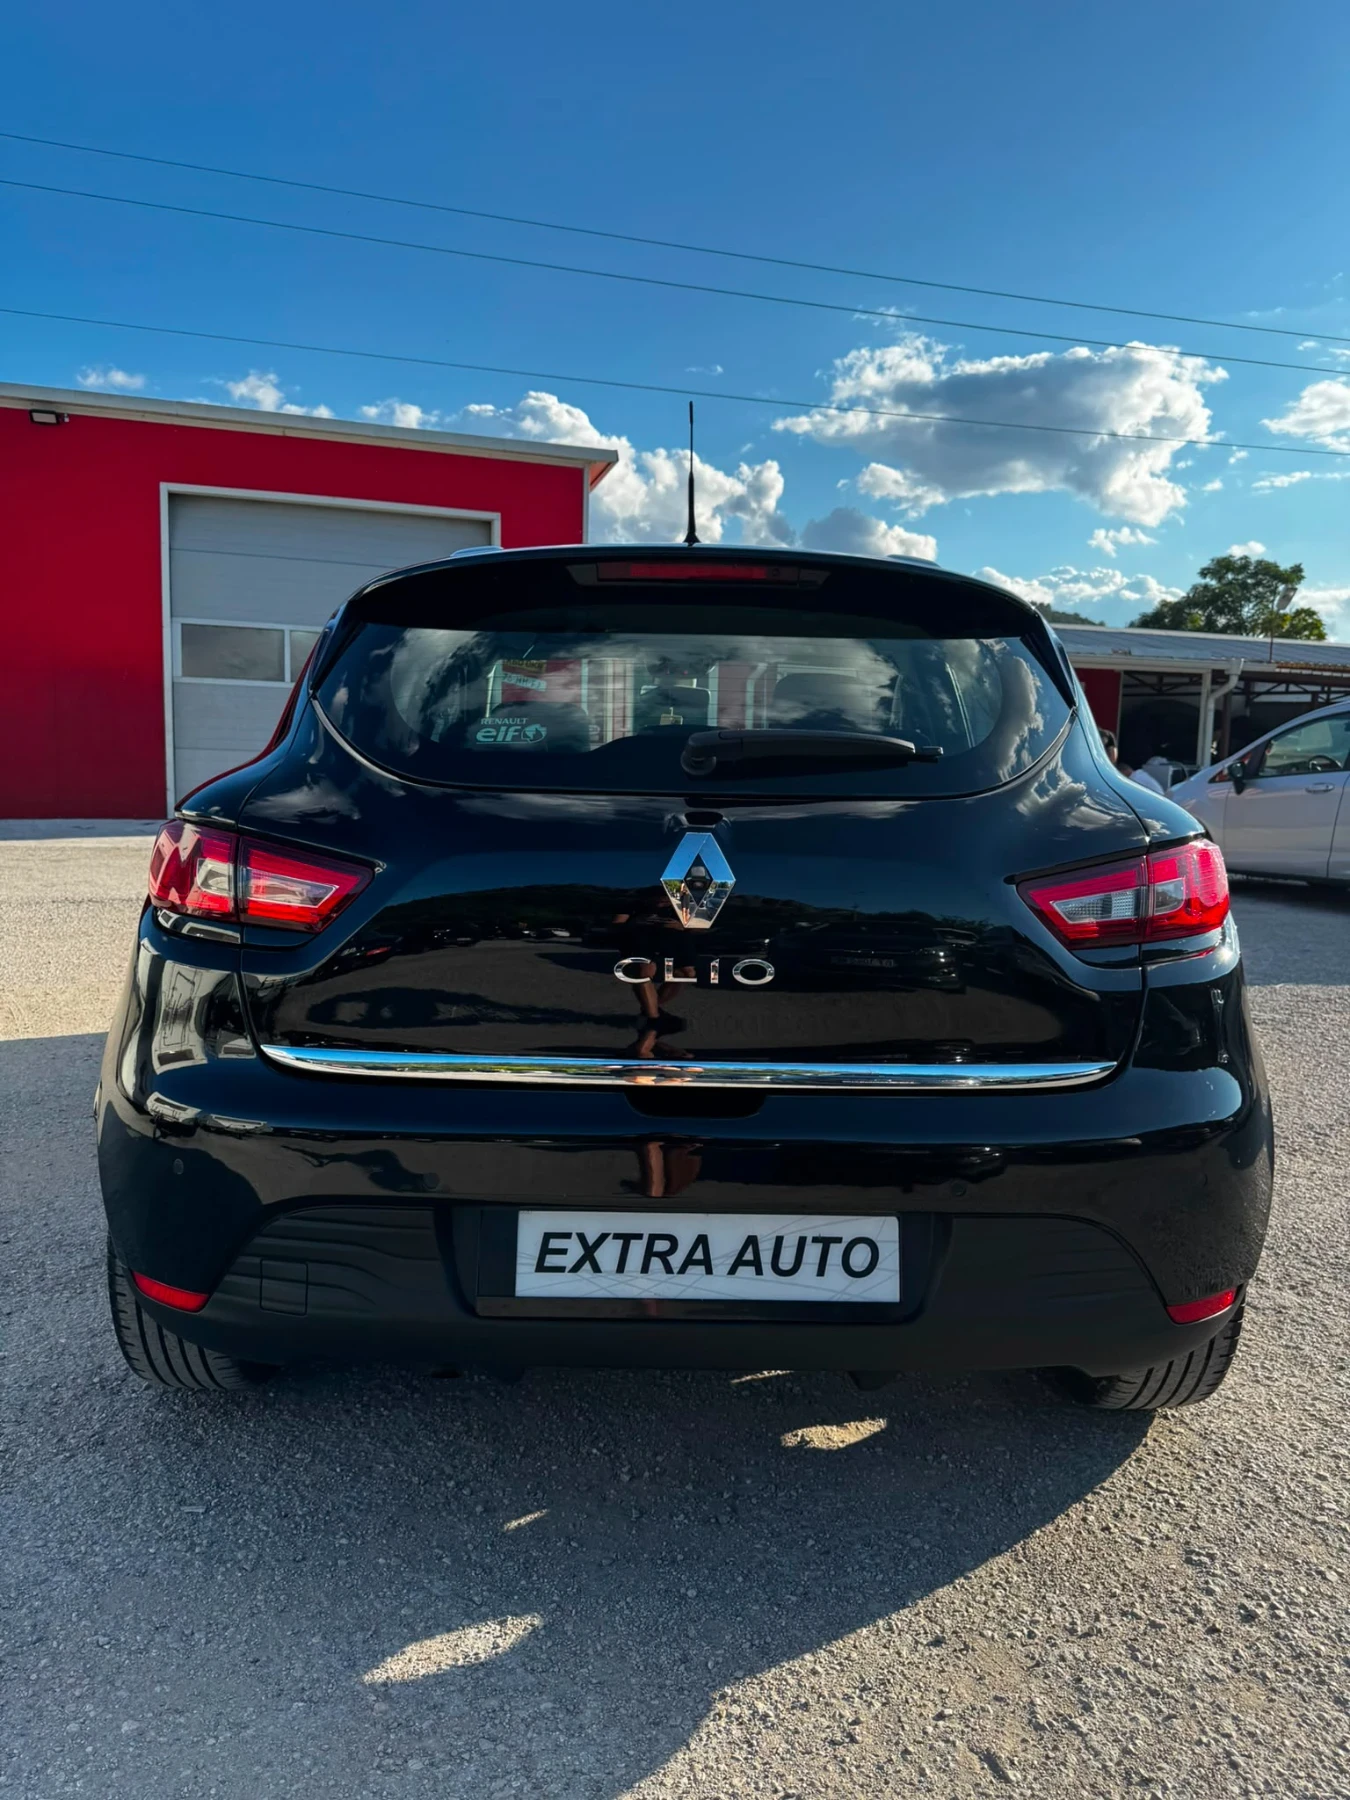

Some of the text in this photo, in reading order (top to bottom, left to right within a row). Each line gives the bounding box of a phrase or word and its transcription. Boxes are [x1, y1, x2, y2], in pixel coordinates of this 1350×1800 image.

[480, 717, 528, 725] RENAULT
[476, 725, 521, 742] elf
[613, 956, 776, 985] CLIO
[534, 1231, 880, 1279] EXTRA AUTO
